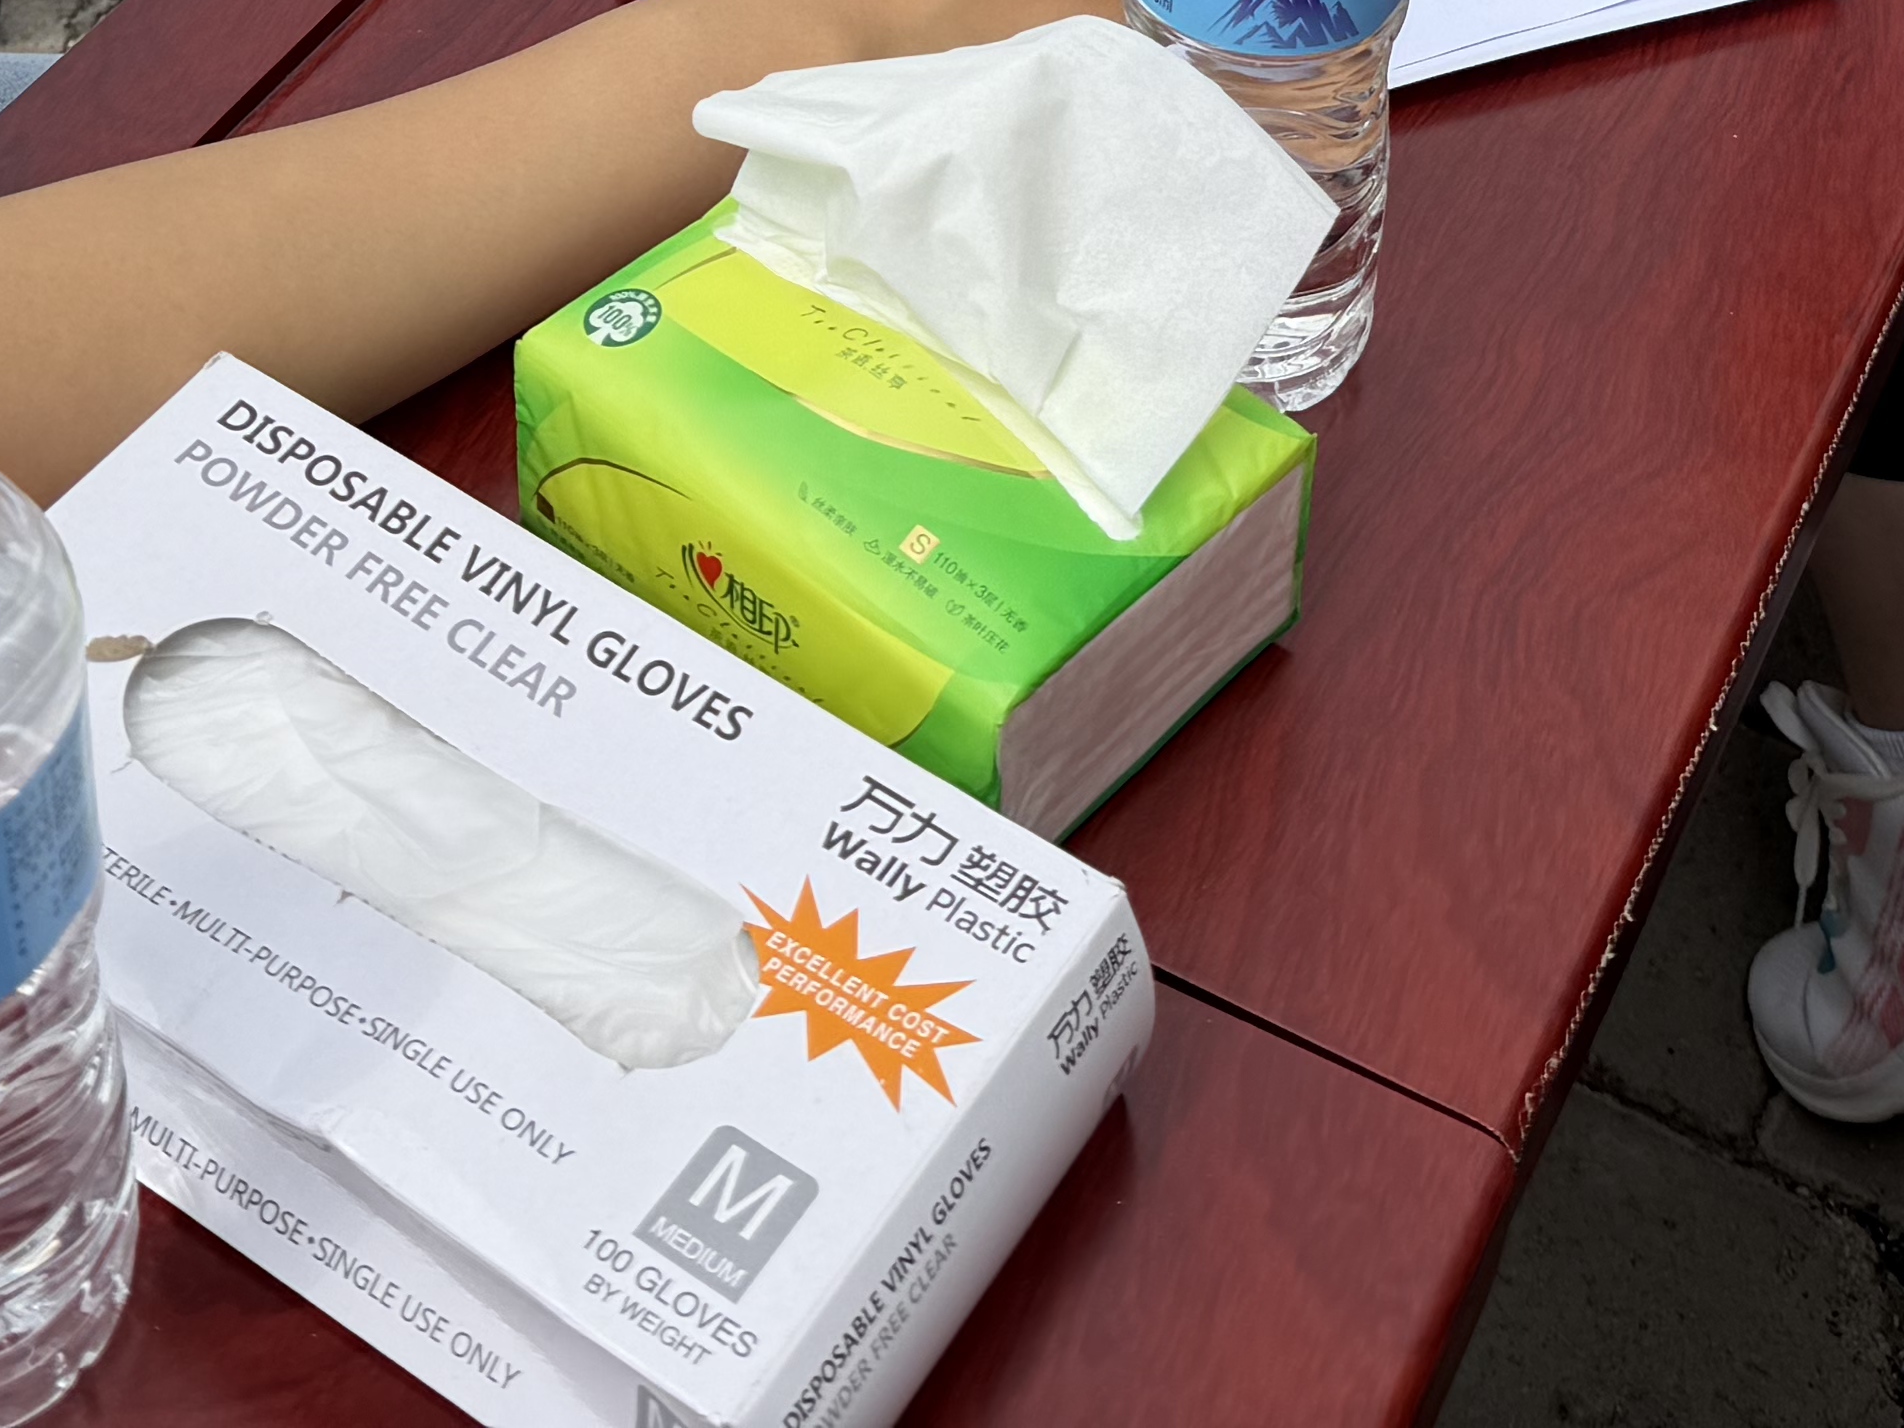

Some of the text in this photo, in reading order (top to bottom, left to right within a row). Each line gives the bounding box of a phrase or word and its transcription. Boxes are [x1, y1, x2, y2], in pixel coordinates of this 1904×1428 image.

[173, 438, 350, 566] POWDER
[345, 550, 450, 632] FREE
[446, 617, 578, 719] CLEAR
[216, 398, 462, 565] DISPOSABLE
[457, 543, 580, 646] VINYL
[586, 630, 755, 743] GLOVES
[909, 531, 932, 556] S
[821, 820, 1037, 964] Wally Plastic
[839, 774, 1069, 936] 万力 塑胶
[102, 844, 172, 907] TERILE
[362, 1015, 453, 1080] SINGLE
[449, 1068, 504, 1116] USE
[500, 1107, 578, 1167] ONLY
[762, 957, 921, 1060] PERFORMANCE
[765, 930, 950, 1045] EXCELLENT COST
[1058, 960, 1139, 1077] Wally Plastic
[647, 1215, 749, 1290] MEDIUM
[686, 1142, 796, 1242] M
[880, 1225, 934, 1294] VINYL
[931, 1137, 993, 1227] GLOVES
[311, 1236, 401, 1309] SINGLE
[399, 1294, 451, 1344] USE
[448, 1330, 523, 1391] ONLY
[580, 1227, 760, 1360] 100 GLOVES
[582, 1271, 714, 1367] BY WEIGHT
[813, 1232, 960, 1428] OWDER FREE CLEAR
